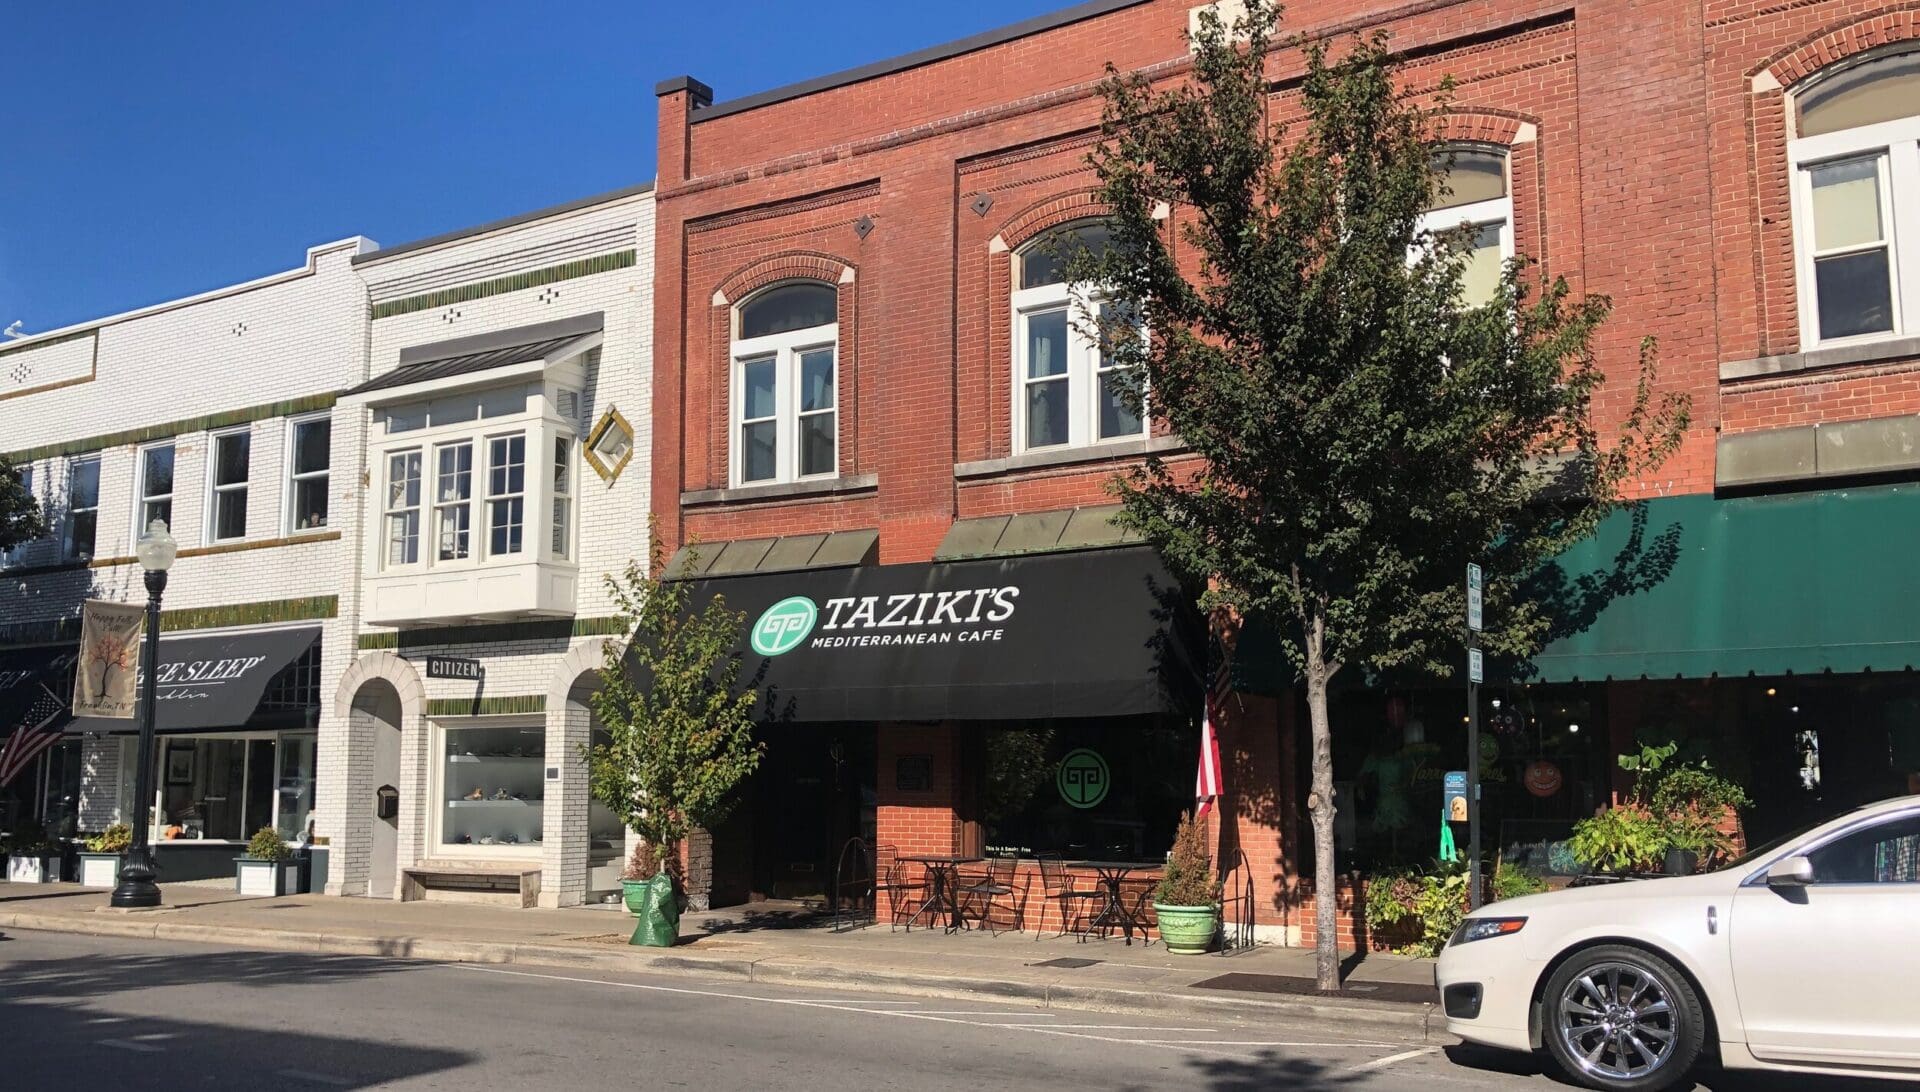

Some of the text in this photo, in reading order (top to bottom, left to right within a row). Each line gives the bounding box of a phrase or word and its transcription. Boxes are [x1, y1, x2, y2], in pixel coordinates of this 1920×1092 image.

[822, 585, 1020, 630] TAZIKI'S
[811, 629, 1005, 649] MEDITERRANEAN CAFE
[432, 660, 478, 677] CITIZEN
